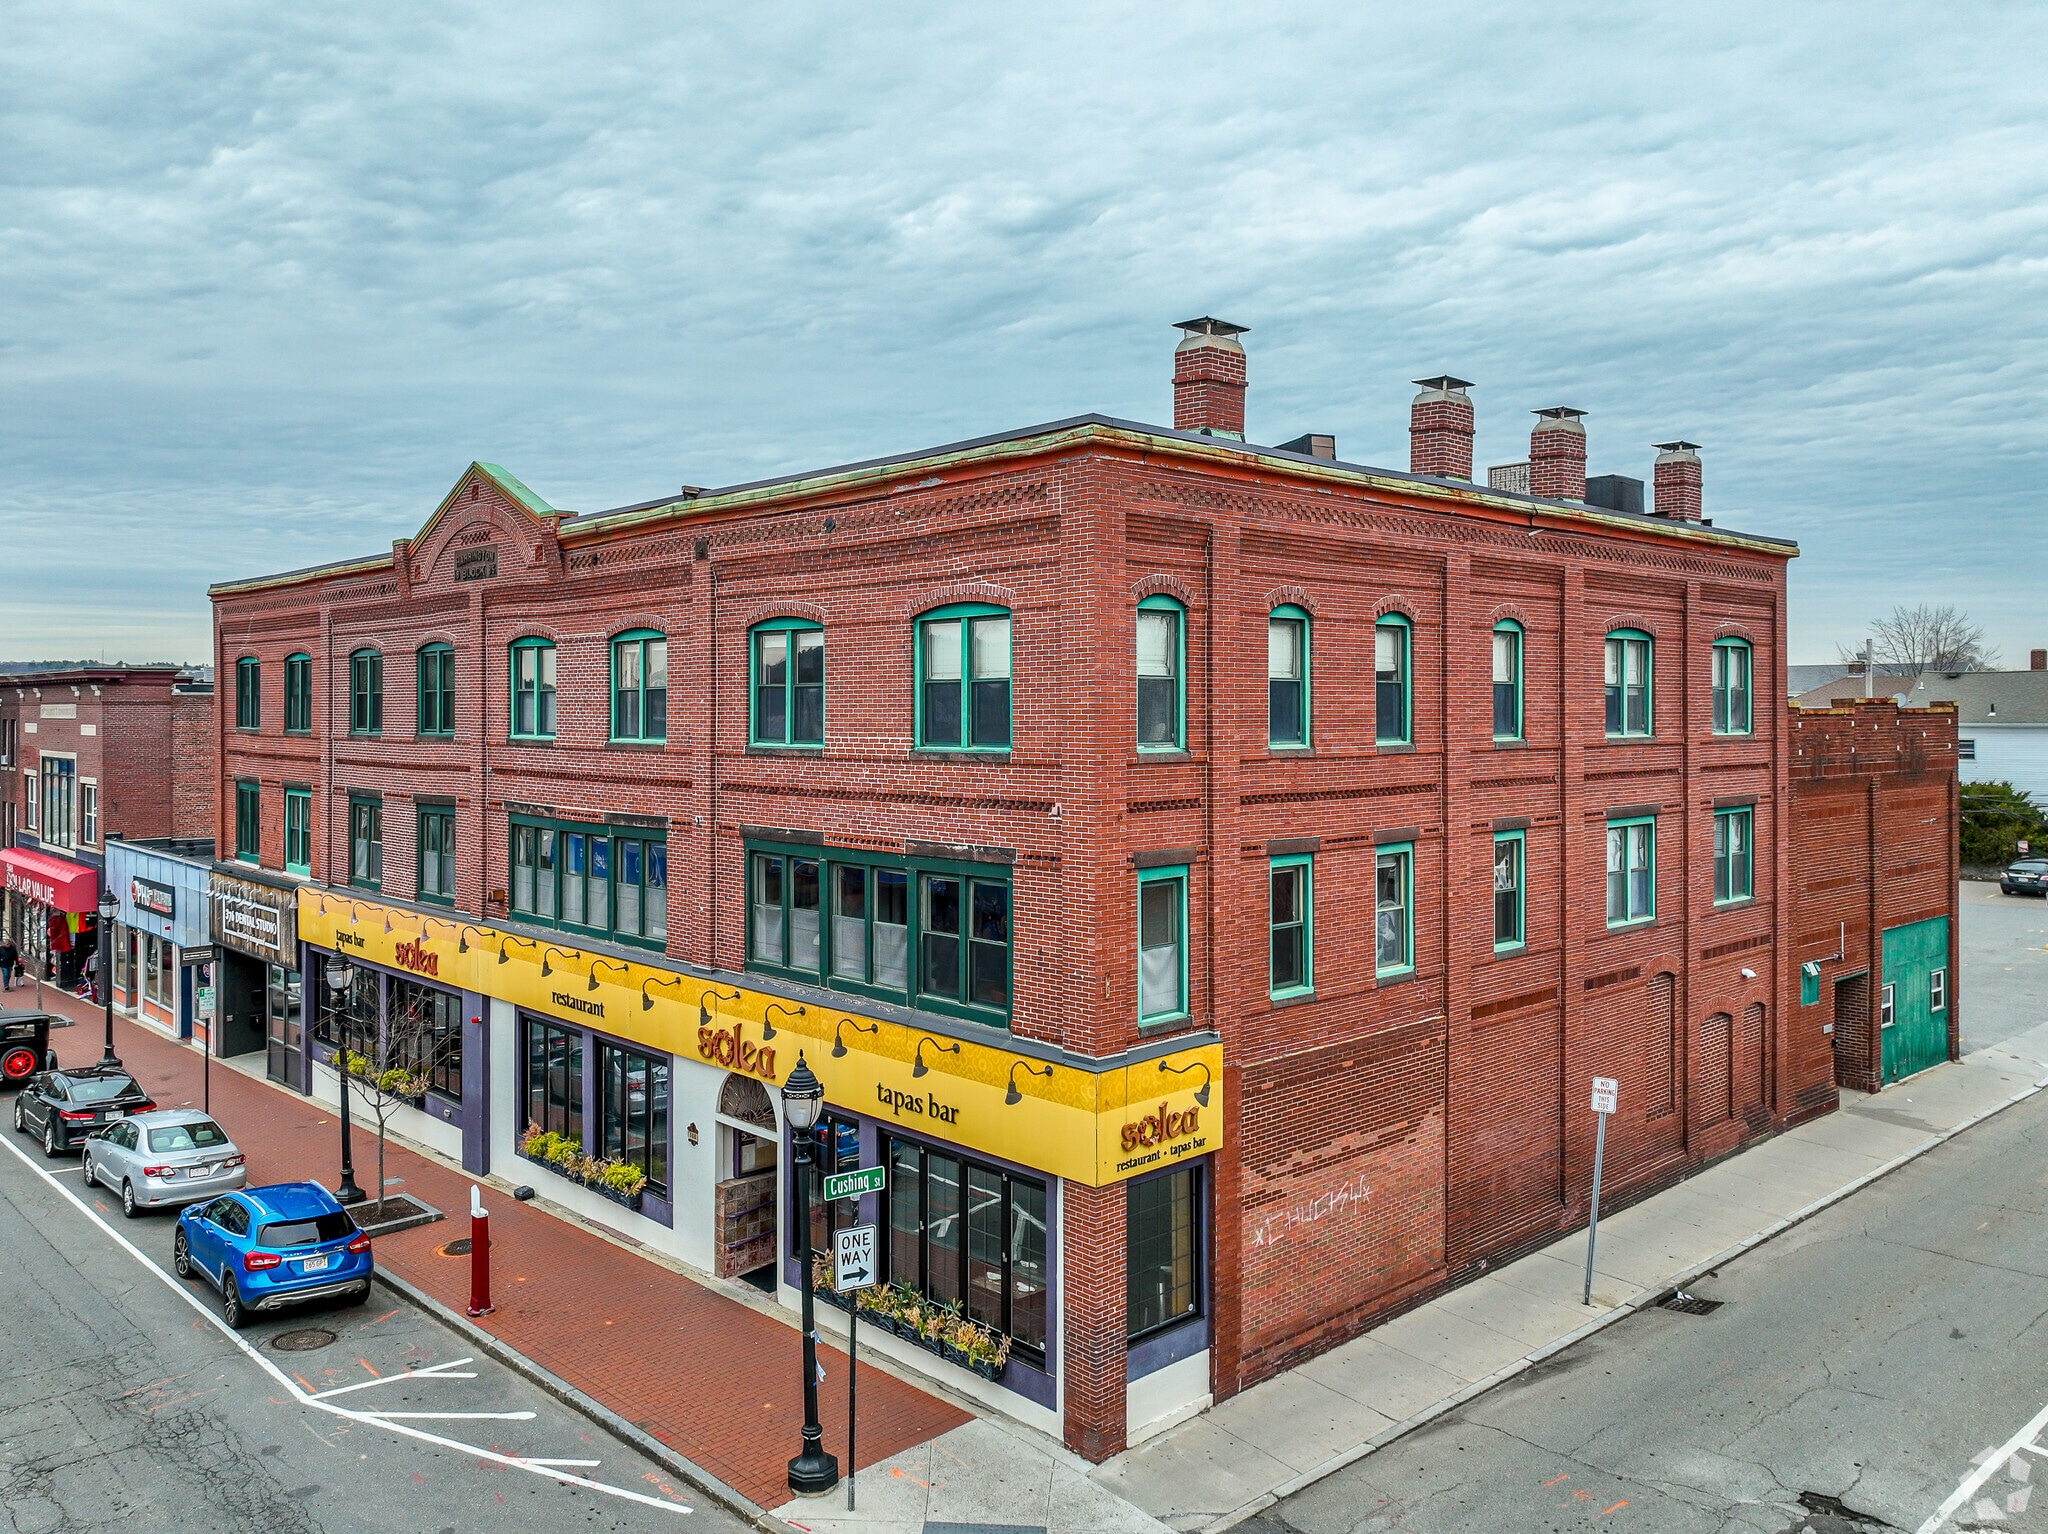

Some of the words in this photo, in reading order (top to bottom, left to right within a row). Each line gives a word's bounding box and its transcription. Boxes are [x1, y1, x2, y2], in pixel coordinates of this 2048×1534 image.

[31, 880, 55, 905] VALUE
[235, 911, 256, 930] DENTAL
[255, 918, 277, 935] STUDIO
[336, 929, 353, 947] tapas
[353, 932, 365, 948] bar
[551, 990, 605, 1019] restaurant
[697, 1023, 776, 1079] solea
[1594, 1088, 1615, 1096] PARKING
[1600, 1080, 1610, 1089] NO
[877, 1082, 924, 1119] tapas
[928, 1092, 960, 1125] bar
[1597, 1102, 1609, 1110] SIDE
[1121, 1100, 1200, 1151] solea
[1116, 1149, 1161, 1172] restaurant
[1170, 1141, 1192, 1158] tapas
[1193, 1137, 1207, 1149] bar
[830, 1173, 870, 1196] Cushing
[873, 1176, 881, 1187] St
[841, 1231, 871, 1250] ONE
[841, 1248, 872, 1267] WAY
